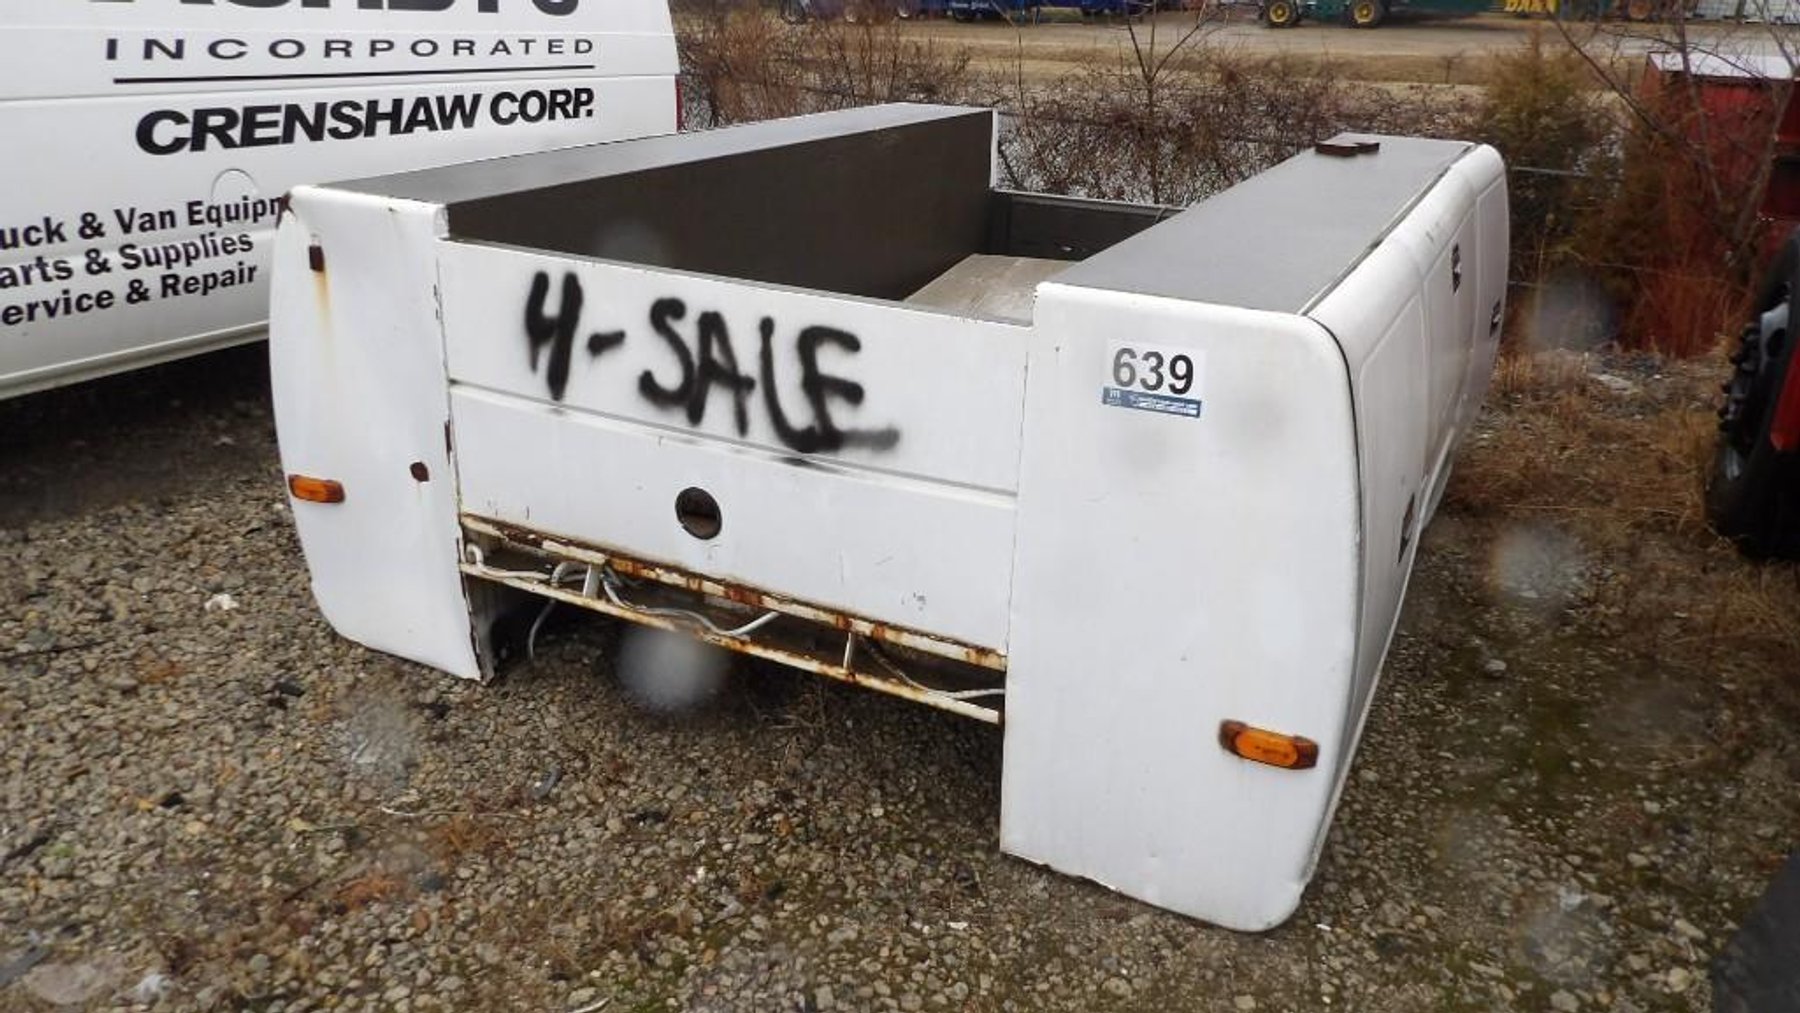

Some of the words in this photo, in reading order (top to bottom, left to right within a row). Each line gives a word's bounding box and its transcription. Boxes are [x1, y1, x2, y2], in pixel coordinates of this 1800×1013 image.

[105, 37, 594, 60] INCORPORATED
[135, 93, 482, 155] CRENSHAW
[489, 87, 595, 126] CORP.
[0, 215, 68, 250] uck
[78, 212, 106, 241] &
[114, 207, 176, 236] Van
[0, 256, 74, 290] arts
[84, 248, 112, 276] &
[118, 231, 254, 271] Supplies
[0, 288, 115, 326] ervice
[125, 279, 150, 305] &
[160, 261, 258, 299] Repair
[1112, 347, 1194, 396] 639
